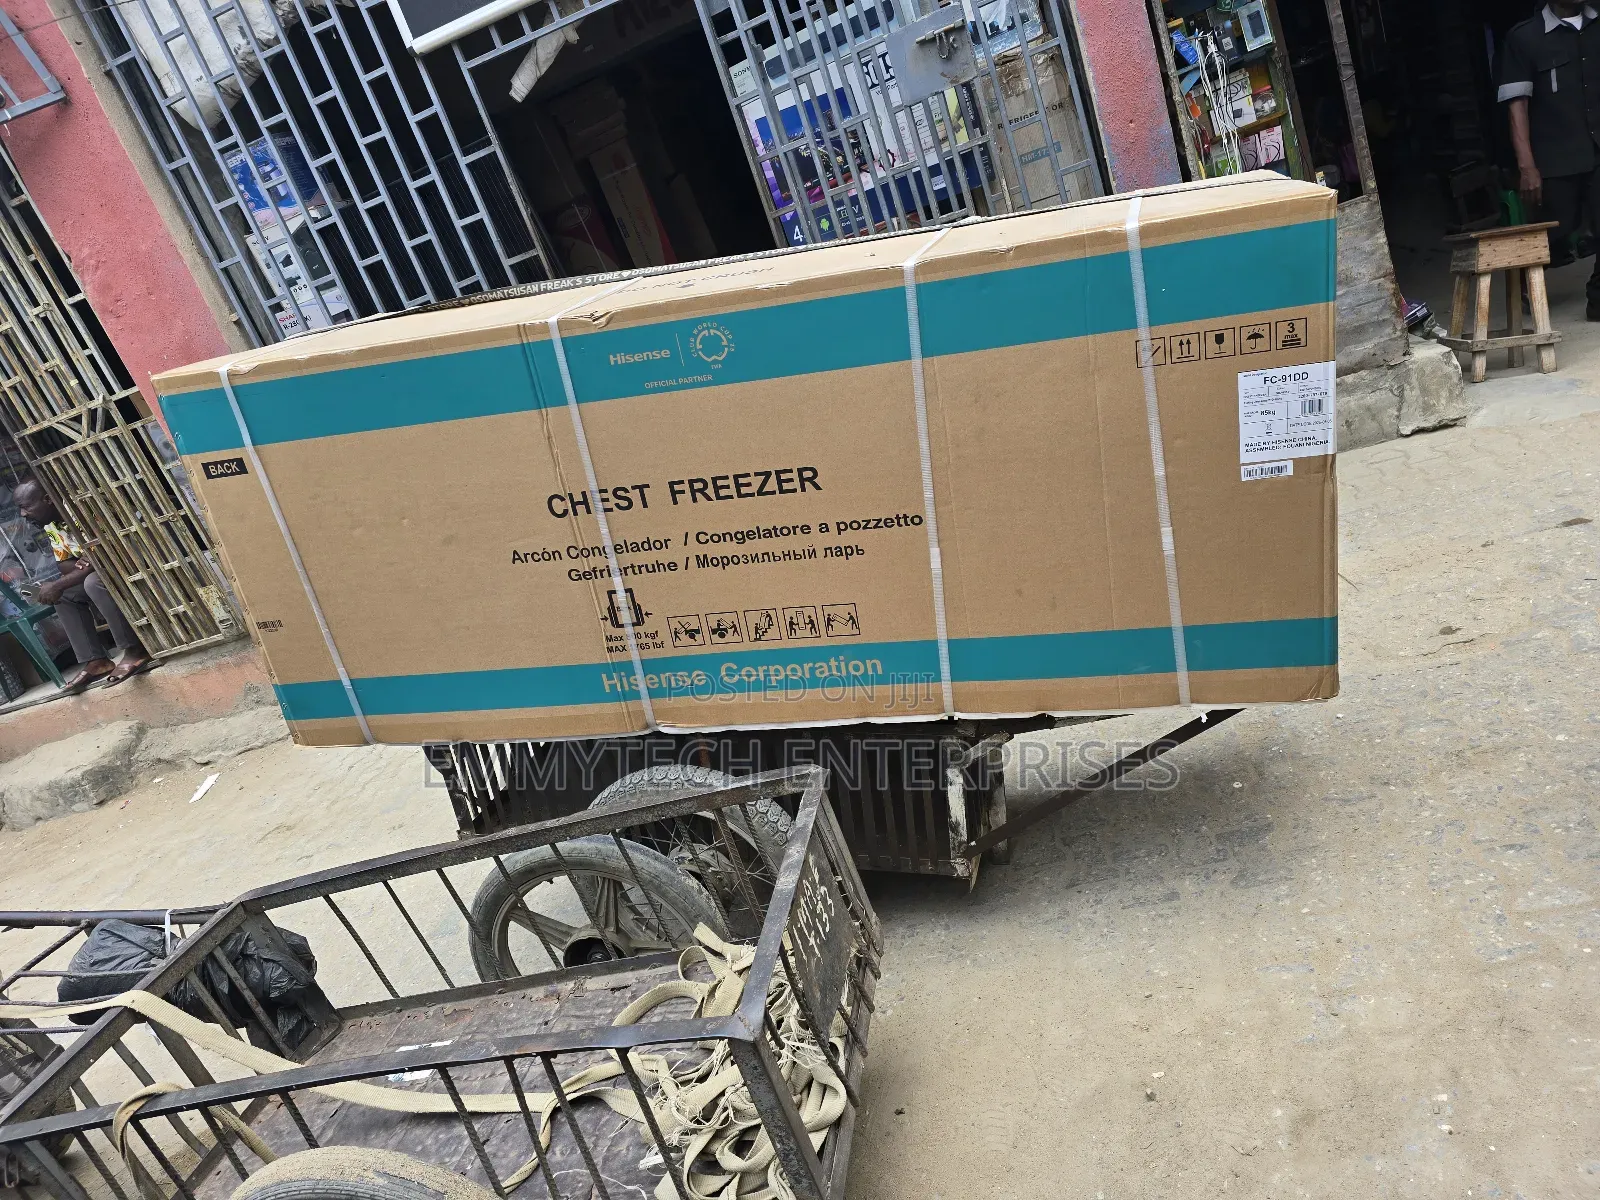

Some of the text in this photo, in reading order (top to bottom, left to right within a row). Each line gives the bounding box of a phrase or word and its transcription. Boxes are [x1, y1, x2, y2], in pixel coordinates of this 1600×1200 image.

[540, 277, 583, 291] FREAK'S
[584, 270, 621, 284] STORE
[692, 321, 718, 335] WORLD
[720, 325, 733, 340] CUP
[1287, 321, 1296, 334] 3
[608, 348, 671, 366] Hisense
[644, 374, 713, 389] OFFICIAL PARTNER
[1263, 371, 1309, 385] FC-91DD
[208, 461, 241, 476] BACK
[547, 466, 823, 519] CHEST FREEZER
[511, 547, 563, 565] Arcón
[695, 521, 812, 545] Congelatore
[818, 522, 830, 534] a
[835, 512, 924, 536] pozzetto
[695, 543, 866, 571] Морозильный ларь
[605, 634, 624, 643] Max
[643, 629, 659, 640] kgf
[606, 644, 628, 654] MAX
[652, 640, 665, 650] lbf
[601, 655, 883, 692] Hisense Corporation
